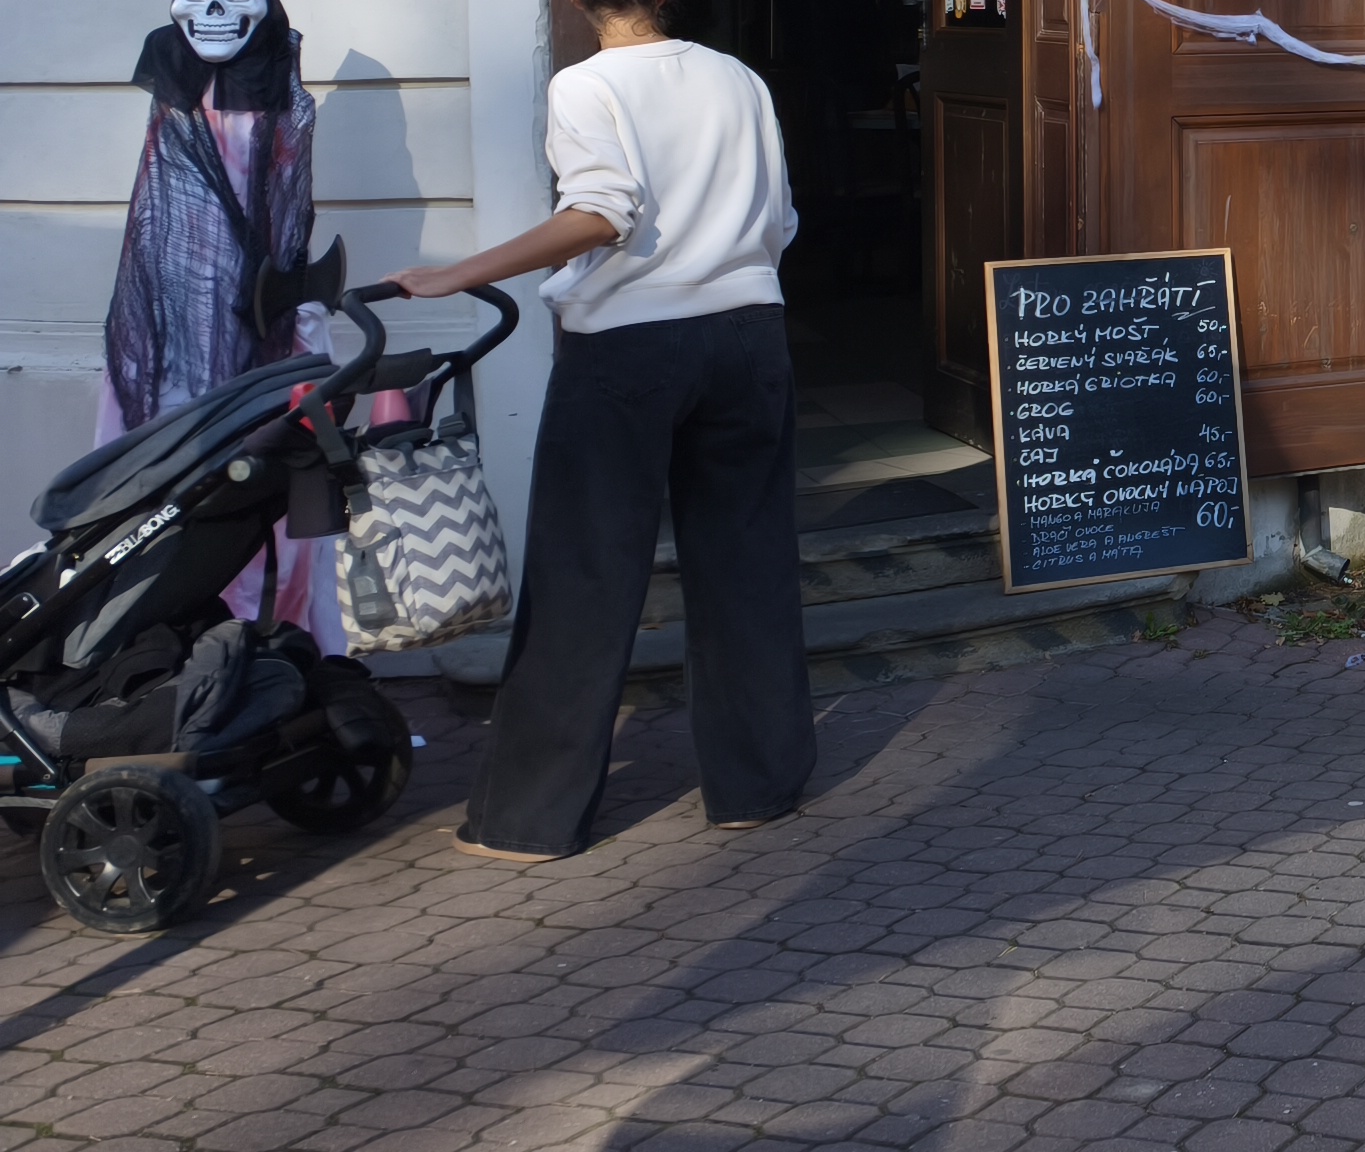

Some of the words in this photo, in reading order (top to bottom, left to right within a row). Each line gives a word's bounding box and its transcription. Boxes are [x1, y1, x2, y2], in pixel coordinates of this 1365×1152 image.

[1011, 285, 1070, 320] PRO
[1082, 272, 1216, 315] ZAHŘÁTÍ
[1015, 324, 1087, 348] HORKÝ
[1095, 317, 1160, 342] MOŠT
[1016, 347, 1095, 371] ČERVENÝ
[1101, 338, 1178, 366] SVAŘÁK
[1017, 374, 1081, 395] HORKÁ
[1085, 372, 1176, 394] GRIOTKA
[1017, 402, 1074, 420] GROG
[1019, 424, 1070, 443] KÁVA
[1019, 448, 1059, 466] ČAJ
[1023, 458, 1100, 488] HORKÁ
[1103, 449, 1199, 479] ČOKOLÁDA
[1176, 473, 1237, 498] NÁPOJ
[1030, 513, 1071, 529] MANGO
[1088, 501, 1160, 520] MARAKUJA
[1033, 544, 1061, 557] ALOE
[1066, 539, 1097, 553] VERA
[1105, 534, 1114, 546] A
[1118, 526, 1186, 544] ANGREŠT
[1075, 524, 1114, 538] OVOCE
[1032, 553, 1084, 571] CITRUS
[1089, 551, 1097, 562] A
[1101, 545, 1143, 560] MÁTA
